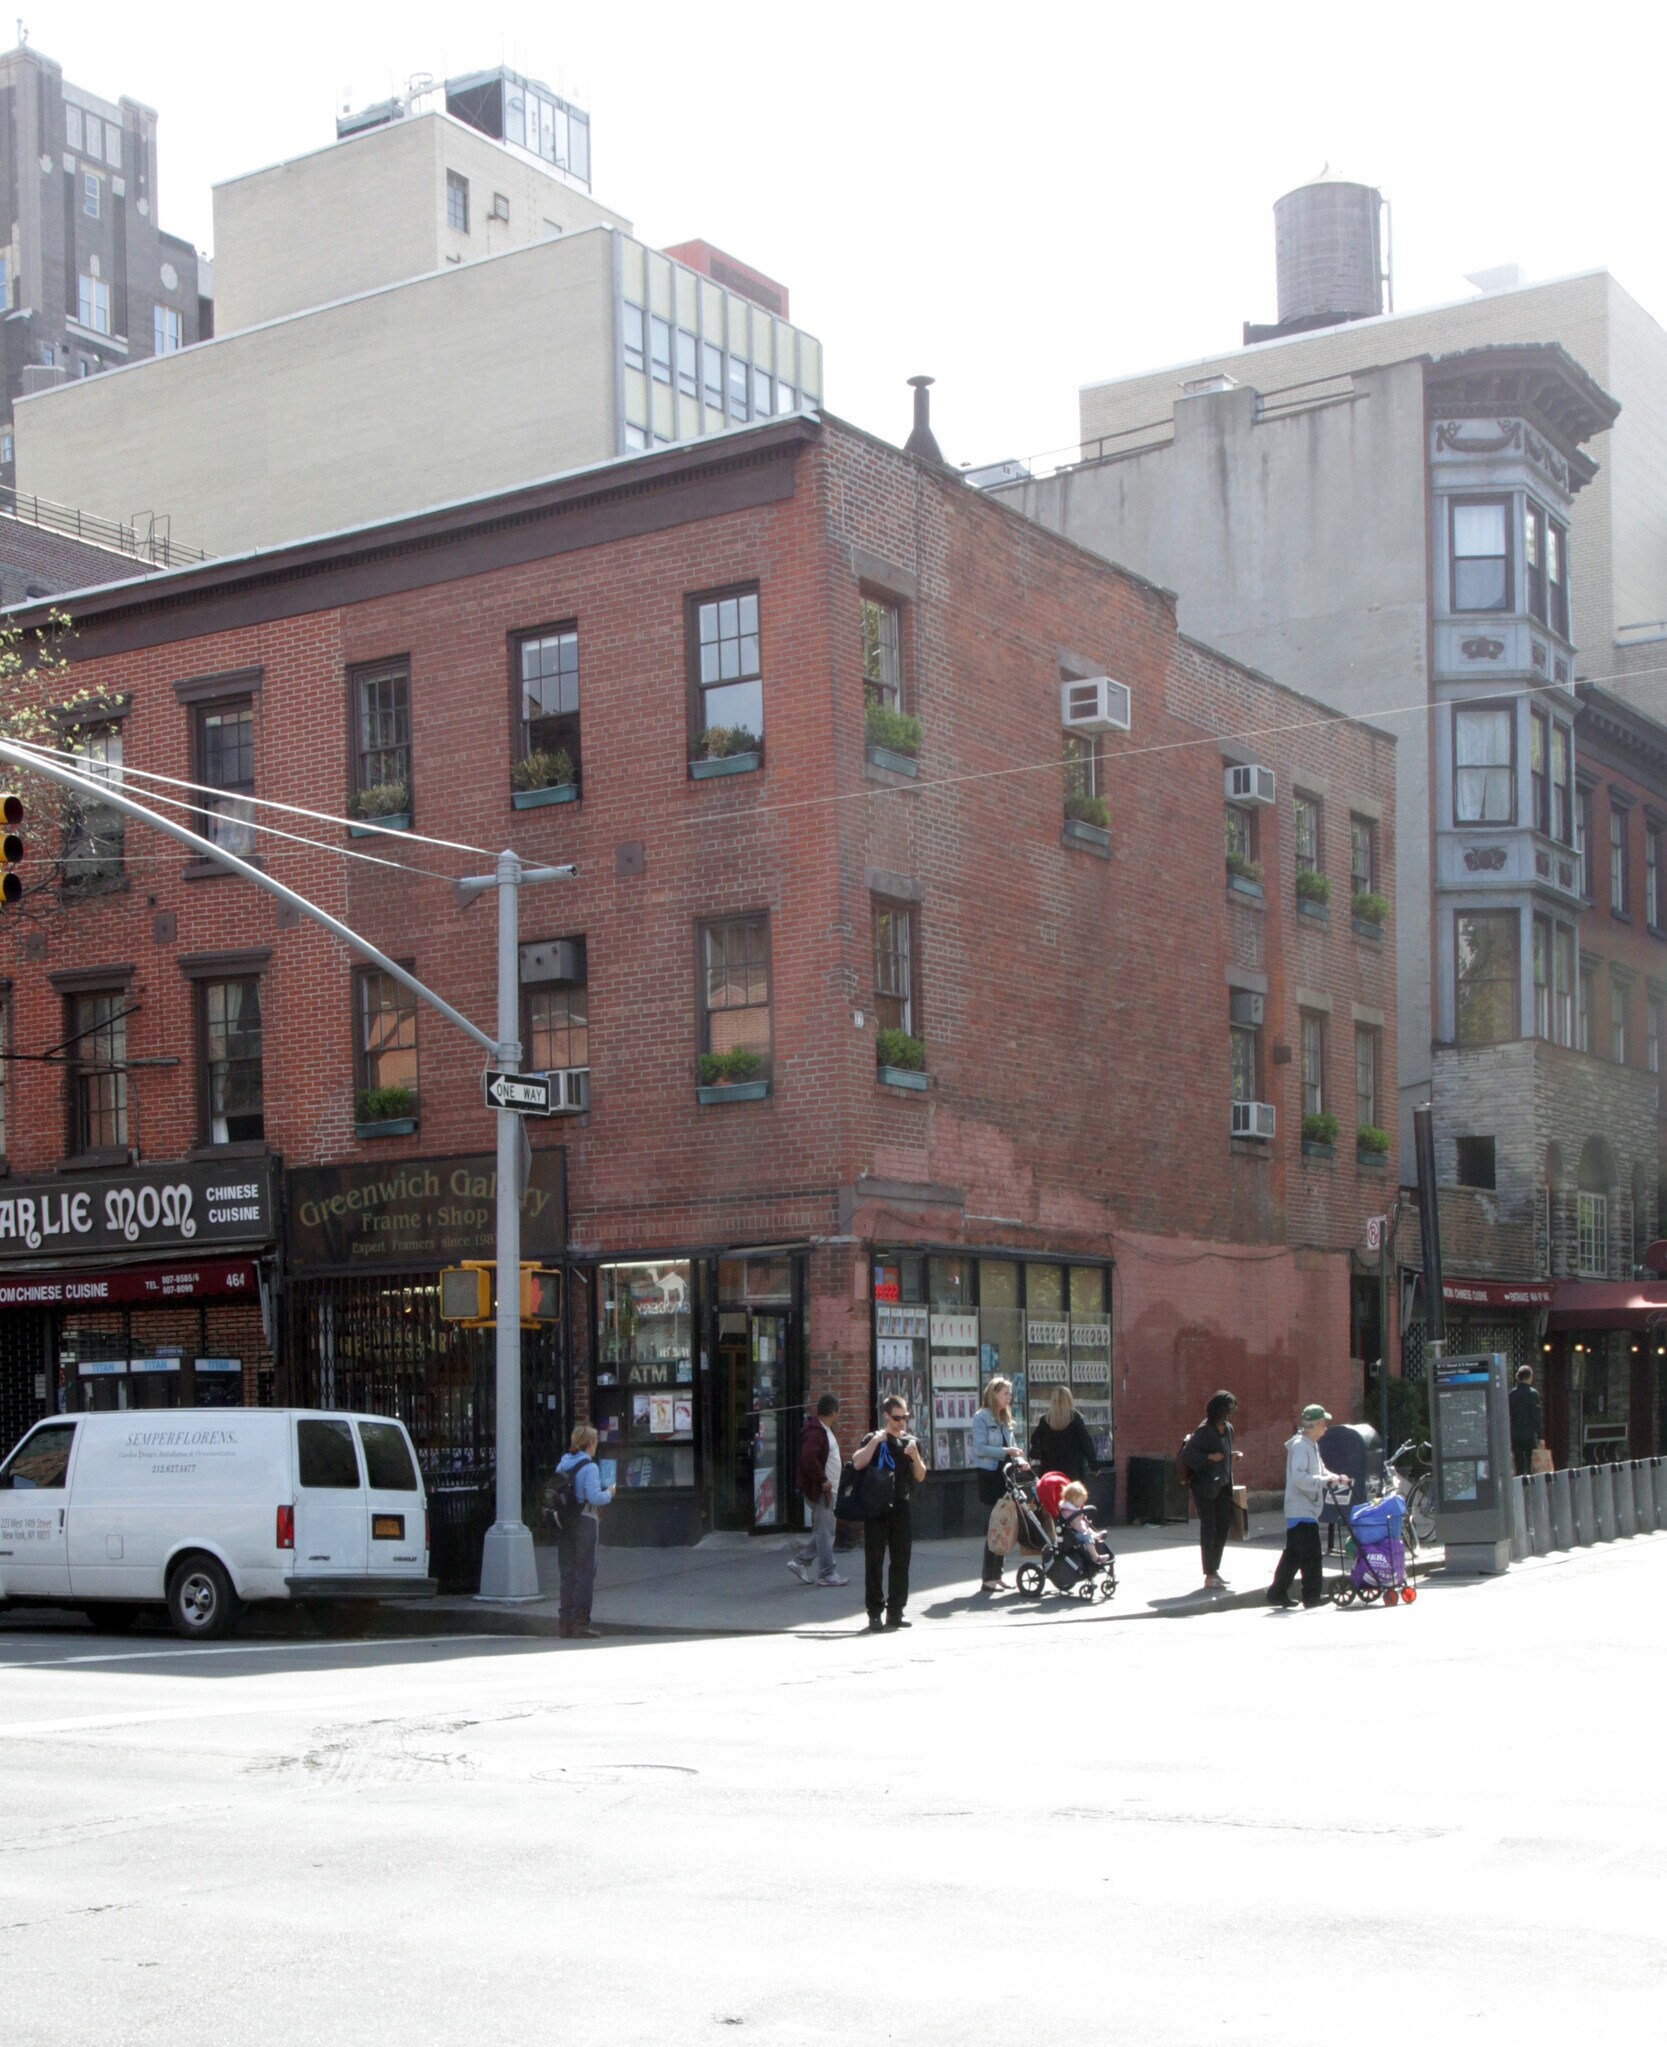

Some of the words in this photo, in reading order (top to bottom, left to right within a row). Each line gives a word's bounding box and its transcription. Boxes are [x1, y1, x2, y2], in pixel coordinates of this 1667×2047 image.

[496, 1084, 515, 1098] ONE
[523, 1087, 542, 1101] WAY
[206, 1184, 259, 1201] CHINESE
[299, 1169, 439, 1227] Greenwich
[450, 1169, 552, 1217] Galry
[105, 1184, 197, 1241] MOM
[208, 1206, 260, 1223] CUISINE
[362, 1212, 421, 1232] Frame
[437, 1206, 488, 1229] Shop
[352, 1241, 386, 1256] Expert
[392, 1238, 435, 1251] Framers
[441, 1235, 471, 1248] since
[475, 1233, 497, 1246] 198
[226, 1273, 245, 1287] 464
[16, 1285, 62, 1301] CHINESE
[65, 1283, 108, 1298] CUISINE
[92, 1363, 115, 1372] TITAN
[144, 1361, 168, 1370] TITAN
[208, 1360, 230, 1369] TITAN
[629, 1364, 668, 1383] ATM
[126, 1431, 235, 1446] SEMPERFLORENS
